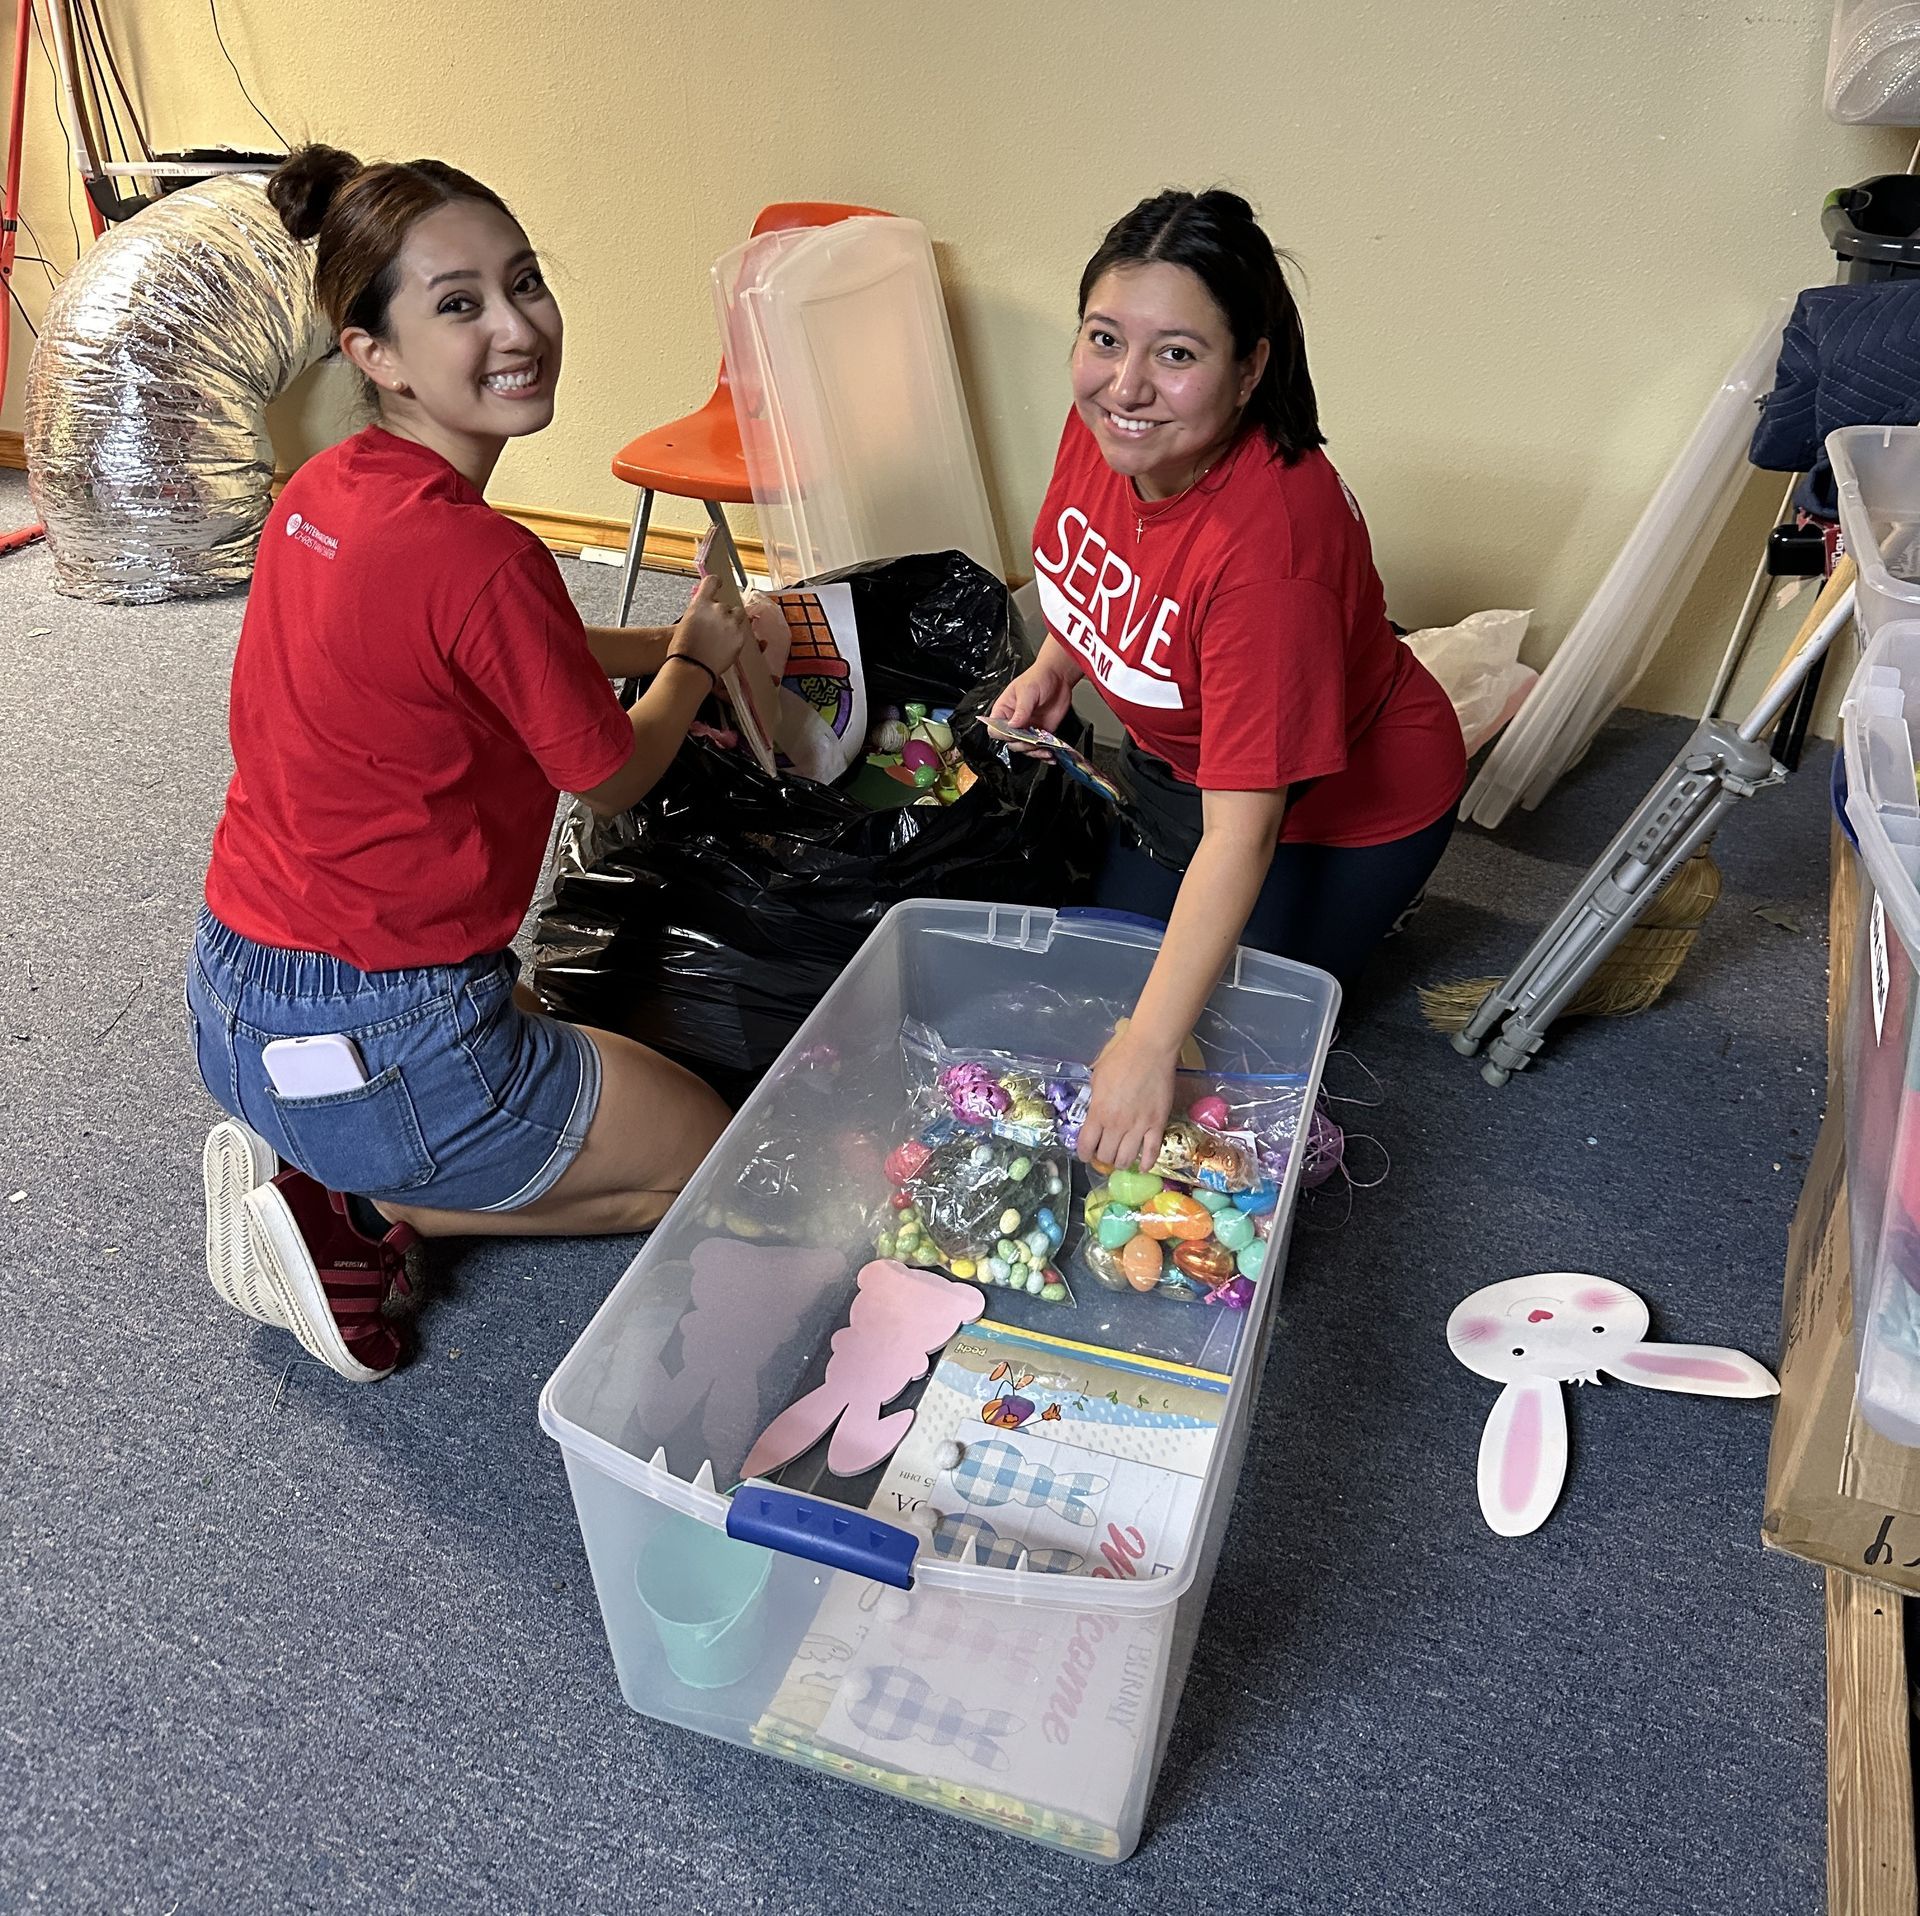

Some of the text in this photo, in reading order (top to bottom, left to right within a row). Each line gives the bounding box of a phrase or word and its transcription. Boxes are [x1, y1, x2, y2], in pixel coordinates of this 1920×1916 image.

[1034, 506, 1180, 678] SERVE
[1066, 613, 1113, 682] TEAM
[1105, 1644, 1152, 1731] BUNNY
